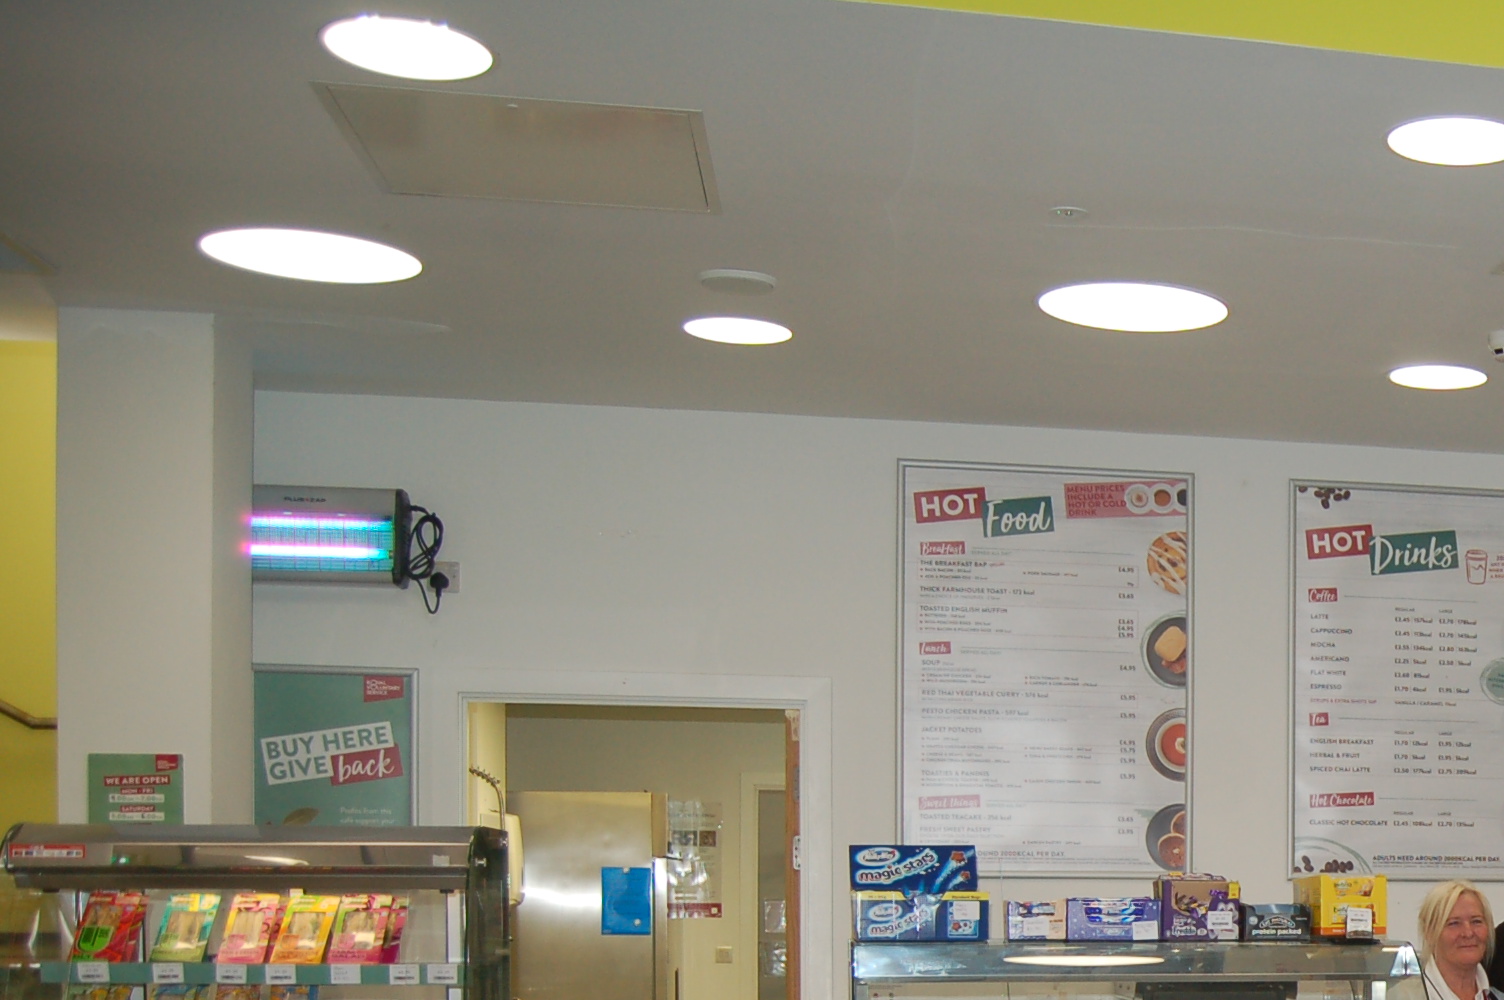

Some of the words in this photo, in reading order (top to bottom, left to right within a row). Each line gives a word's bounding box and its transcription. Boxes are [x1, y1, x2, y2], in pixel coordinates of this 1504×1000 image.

[921, 495, 978, 517] HOT
[987, 500, 1050, 537] Food
[922, 543, 963, 555] Breakfast
[1313, 531, 1365, 553] HOT
[1369, 536, 1456, 575] Drinks
[1310, 589, 1337, 601] Coffee
[1311, 714, 1327, 725] Tea
[266, 736, 314, 760] BUY
[323, 726, 388, 751] HERE
[270, 756, 328, 780] GIVE
[339, 749, 394, 782] back
[1312, 794, 1327, 806] Hot
[1330, 794, 1372, 805] Chocolate
[858, 865, 902, 884] magic
[904, 851, 934, 873] stars
